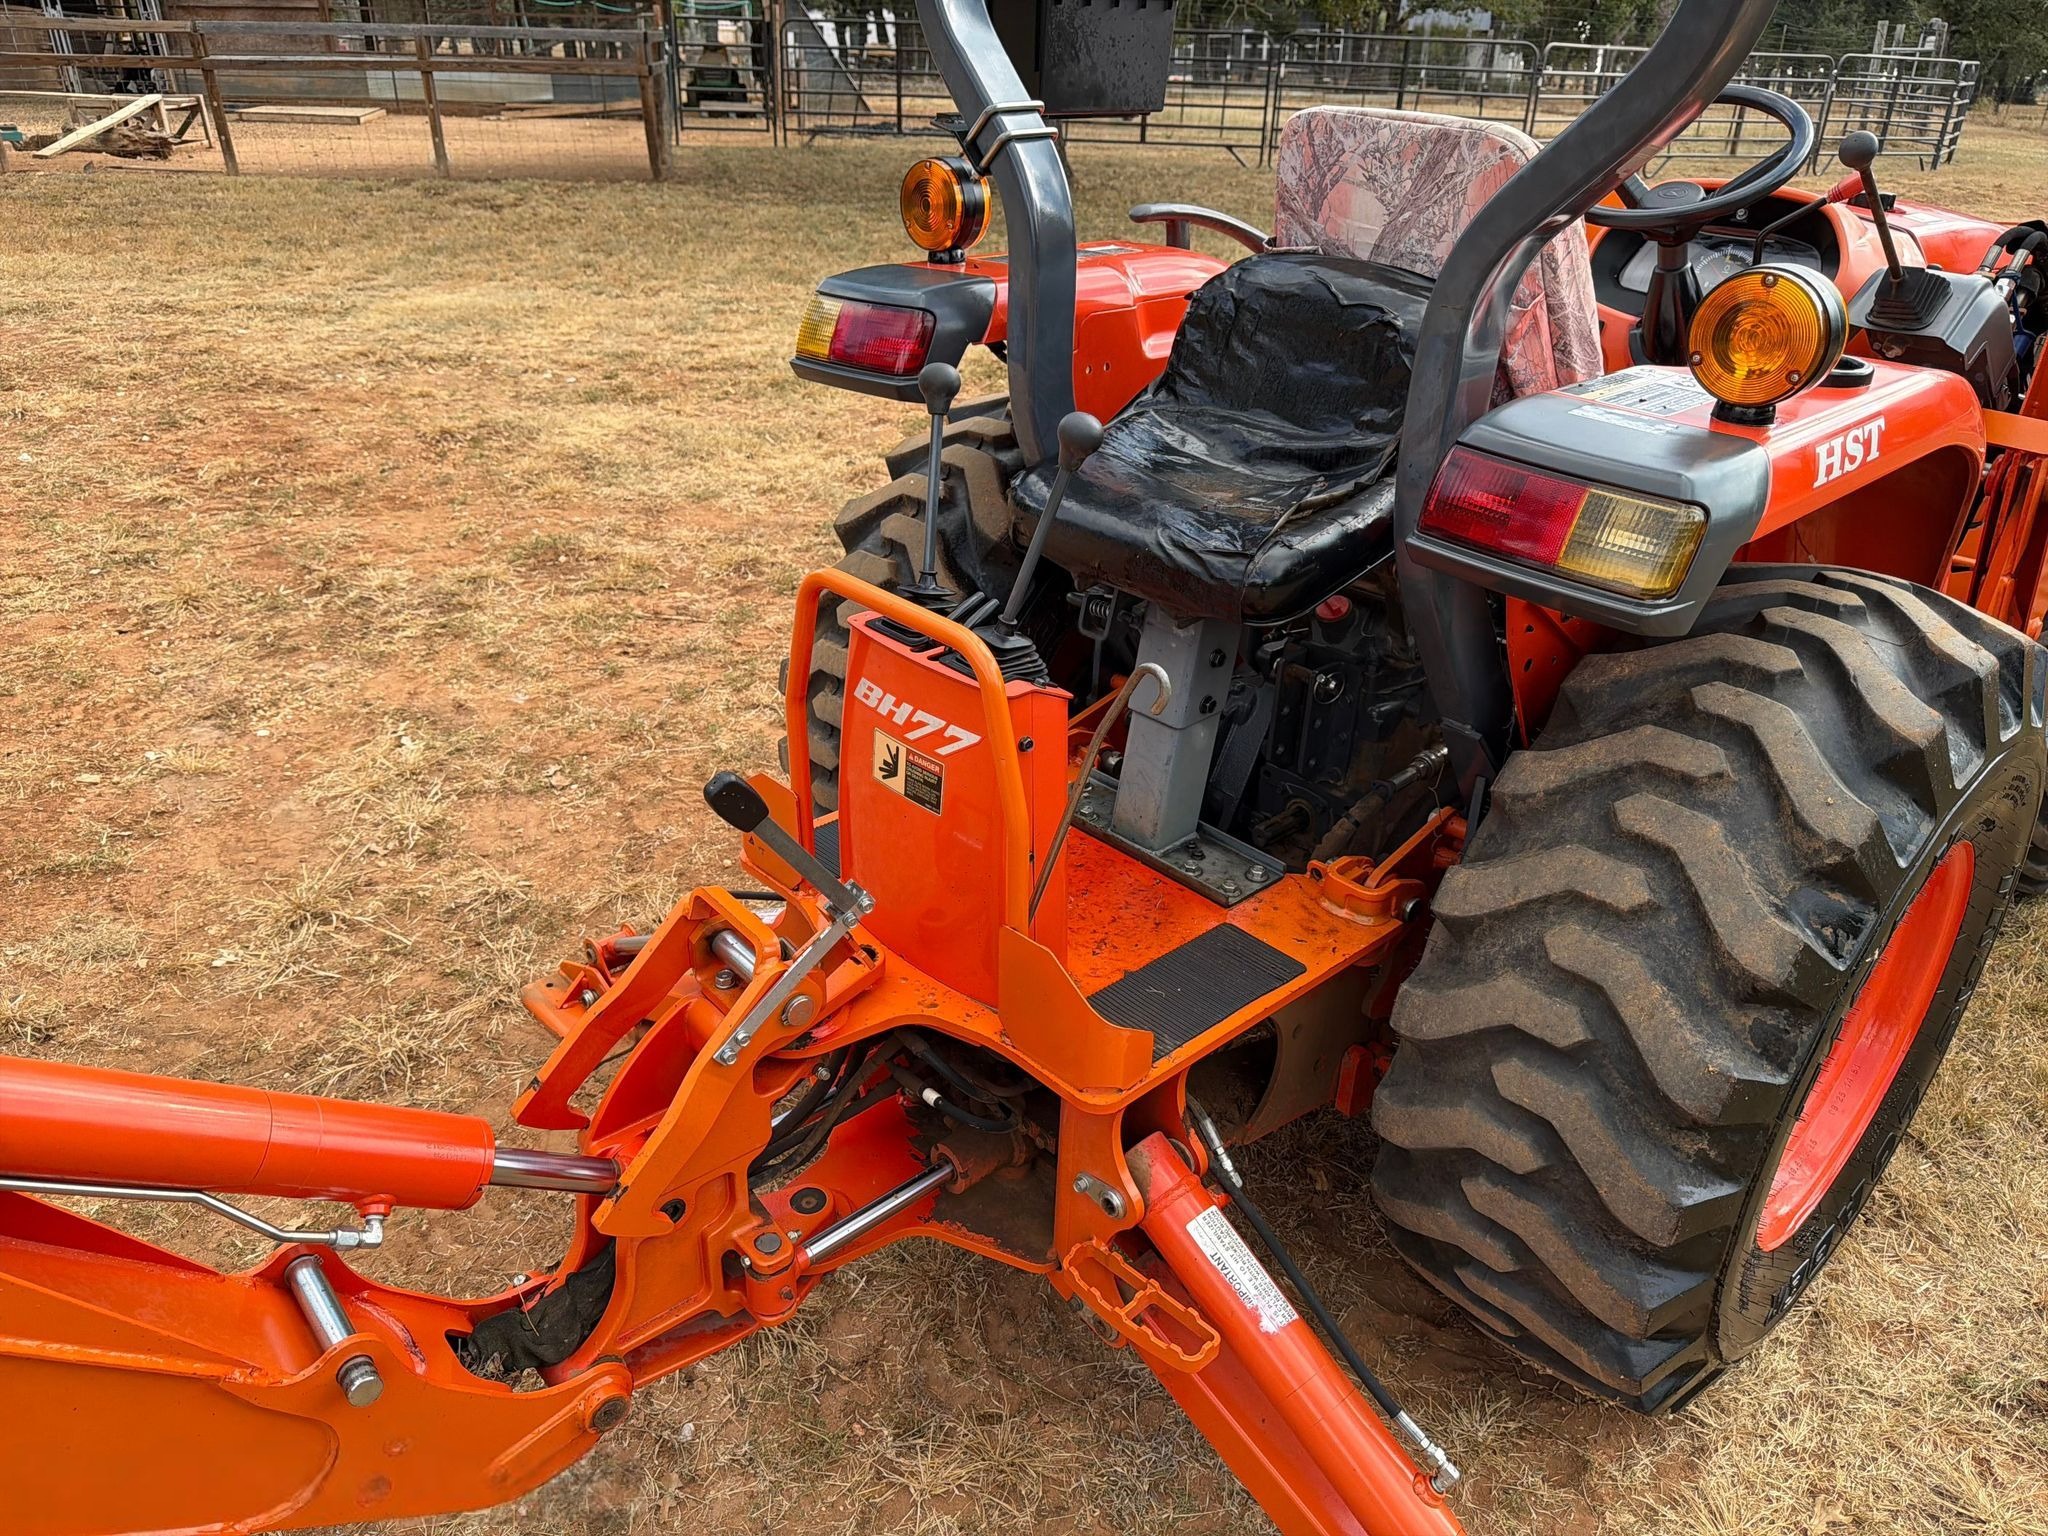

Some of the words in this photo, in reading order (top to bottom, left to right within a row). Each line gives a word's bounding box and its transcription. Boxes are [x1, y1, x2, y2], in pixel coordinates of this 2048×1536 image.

[1813, 414, 1886, 489] HST
[853, 676, 982, 756] BH77
[914, 754, 939, 773] DANGER
[1200, 1215, 1230, 1252] STABILIZER
[1229, 1252, 1239, 1264] HIT
